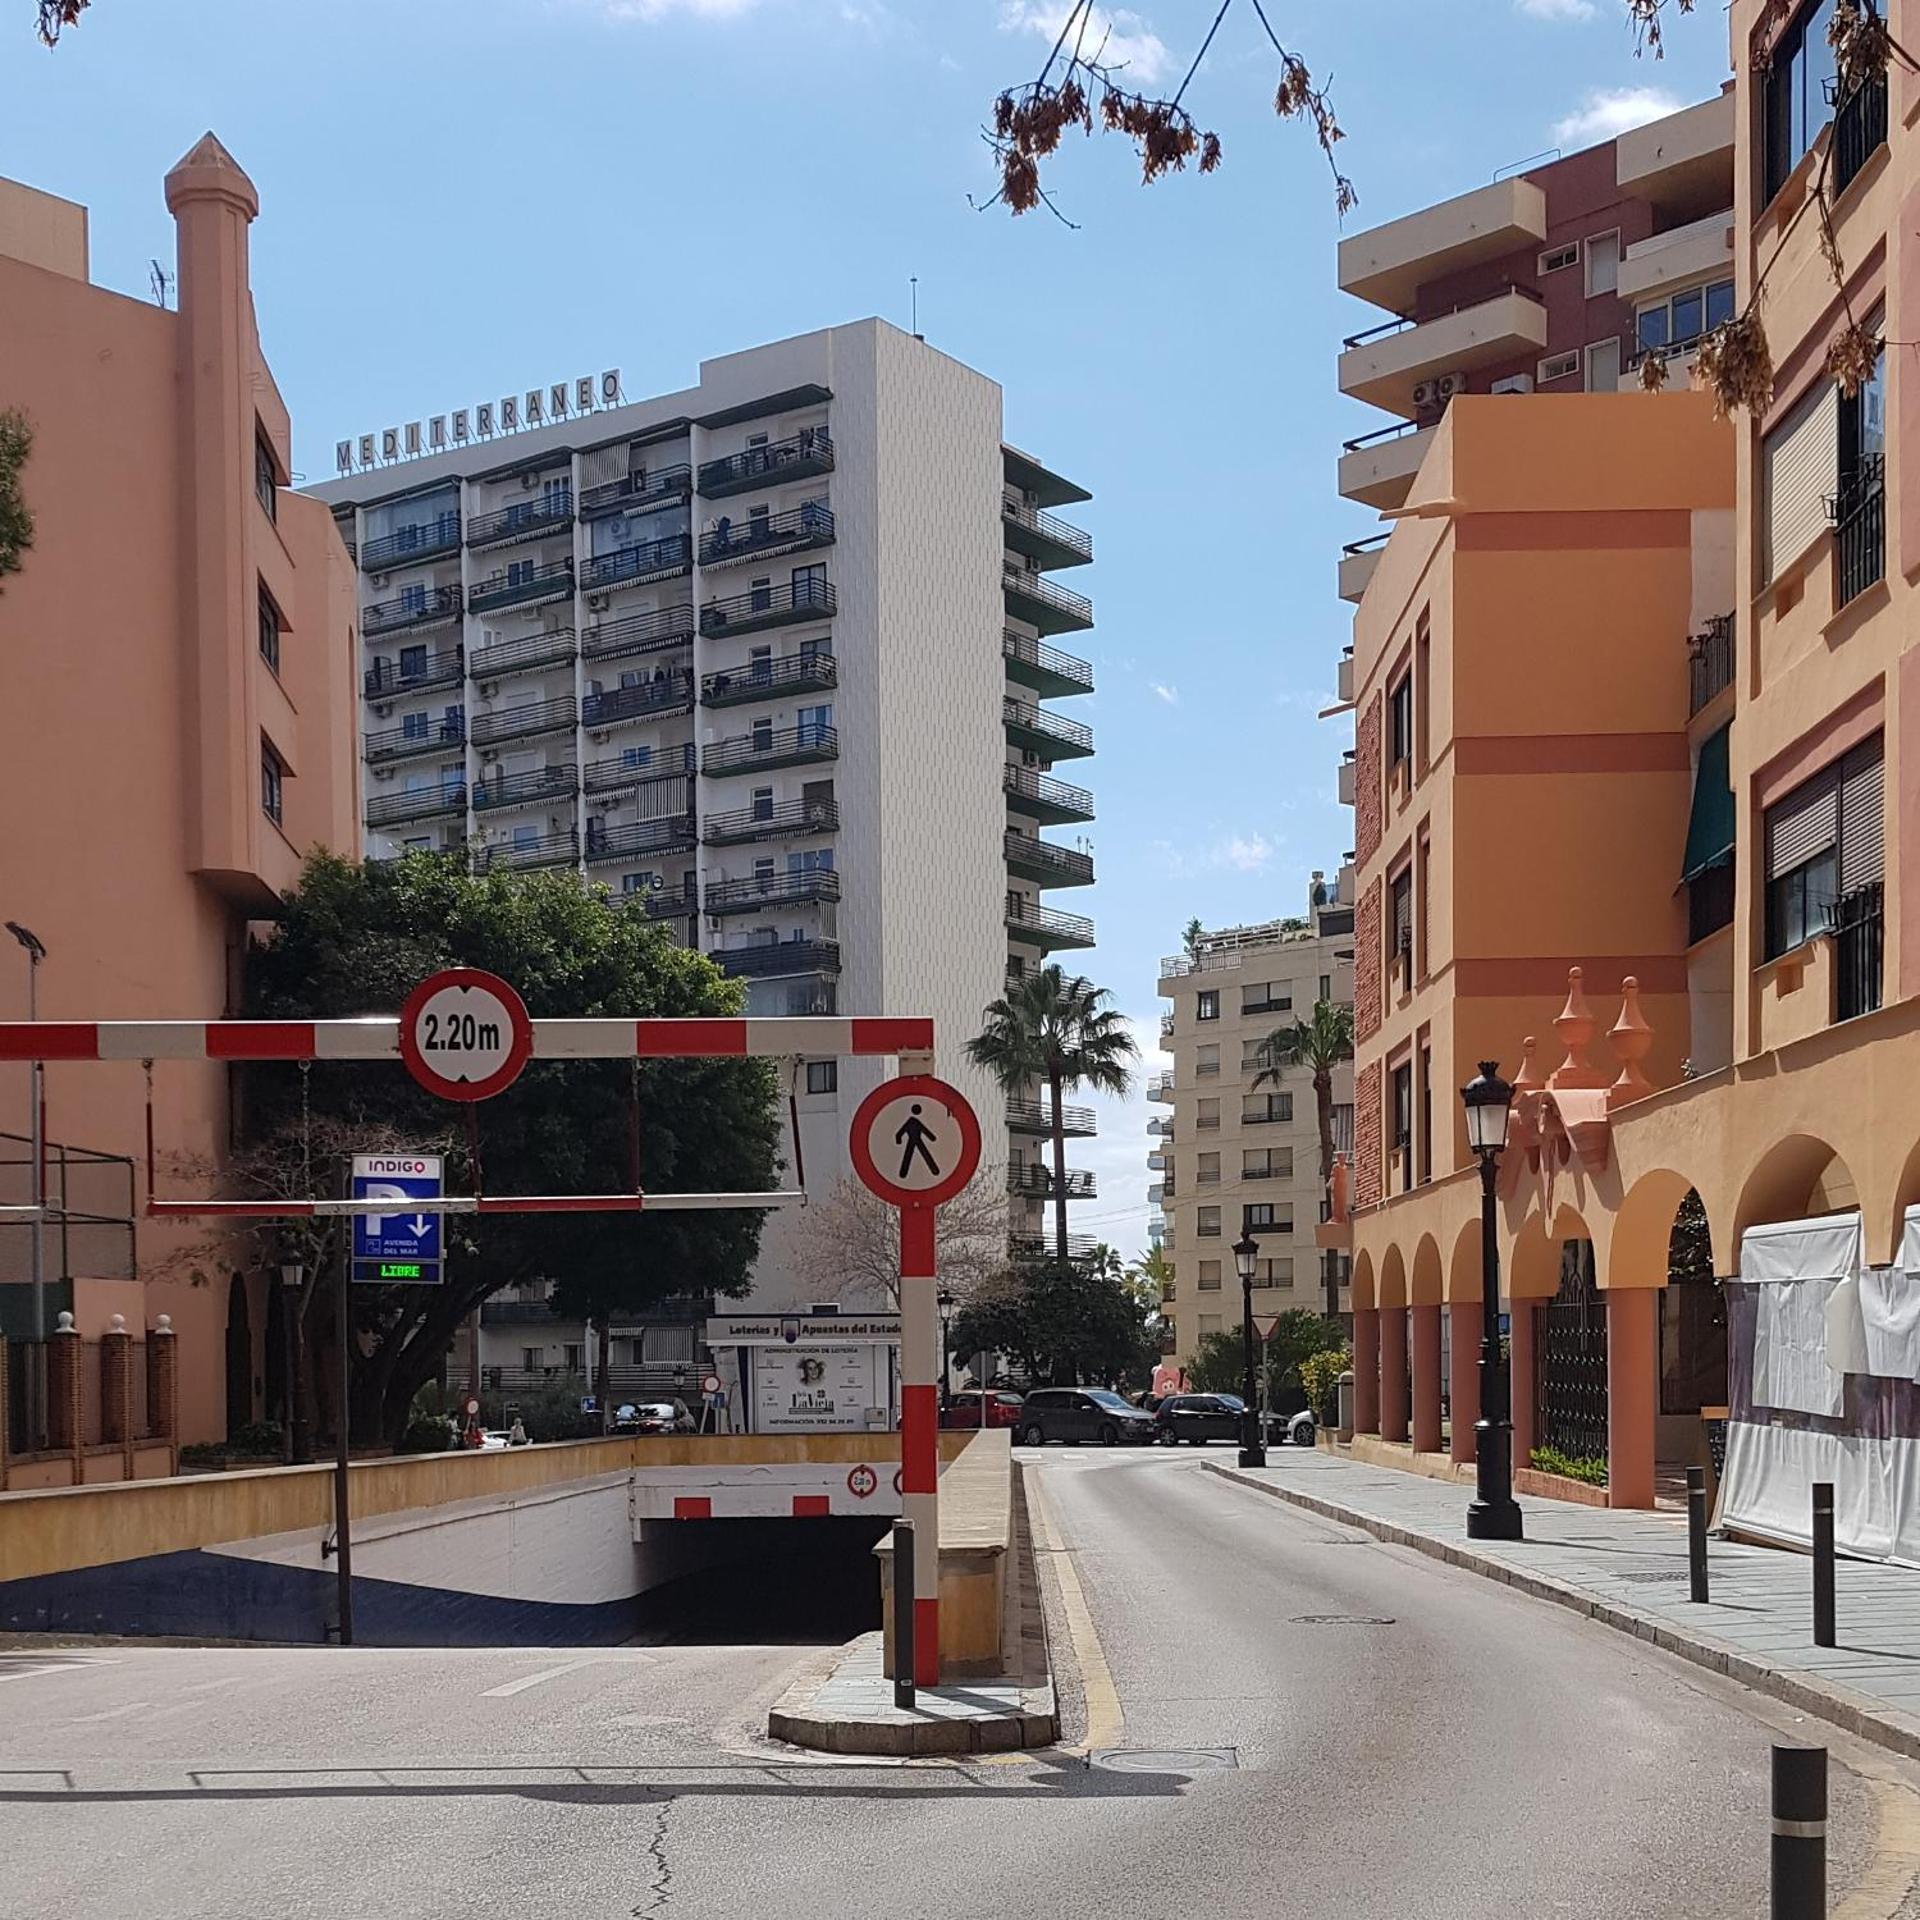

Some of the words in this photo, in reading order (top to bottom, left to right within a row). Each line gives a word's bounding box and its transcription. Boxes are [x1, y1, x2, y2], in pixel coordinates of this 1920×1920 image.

[336, 370, 620, 469] MEDITERRANEO
[369, 1160, 425, 1173] INDIGO
[381, 1265, 420, 1277] LIBRE
[801, 1324, 849, 1337] Apuestas
[851, 1323, 867, 1334] del
